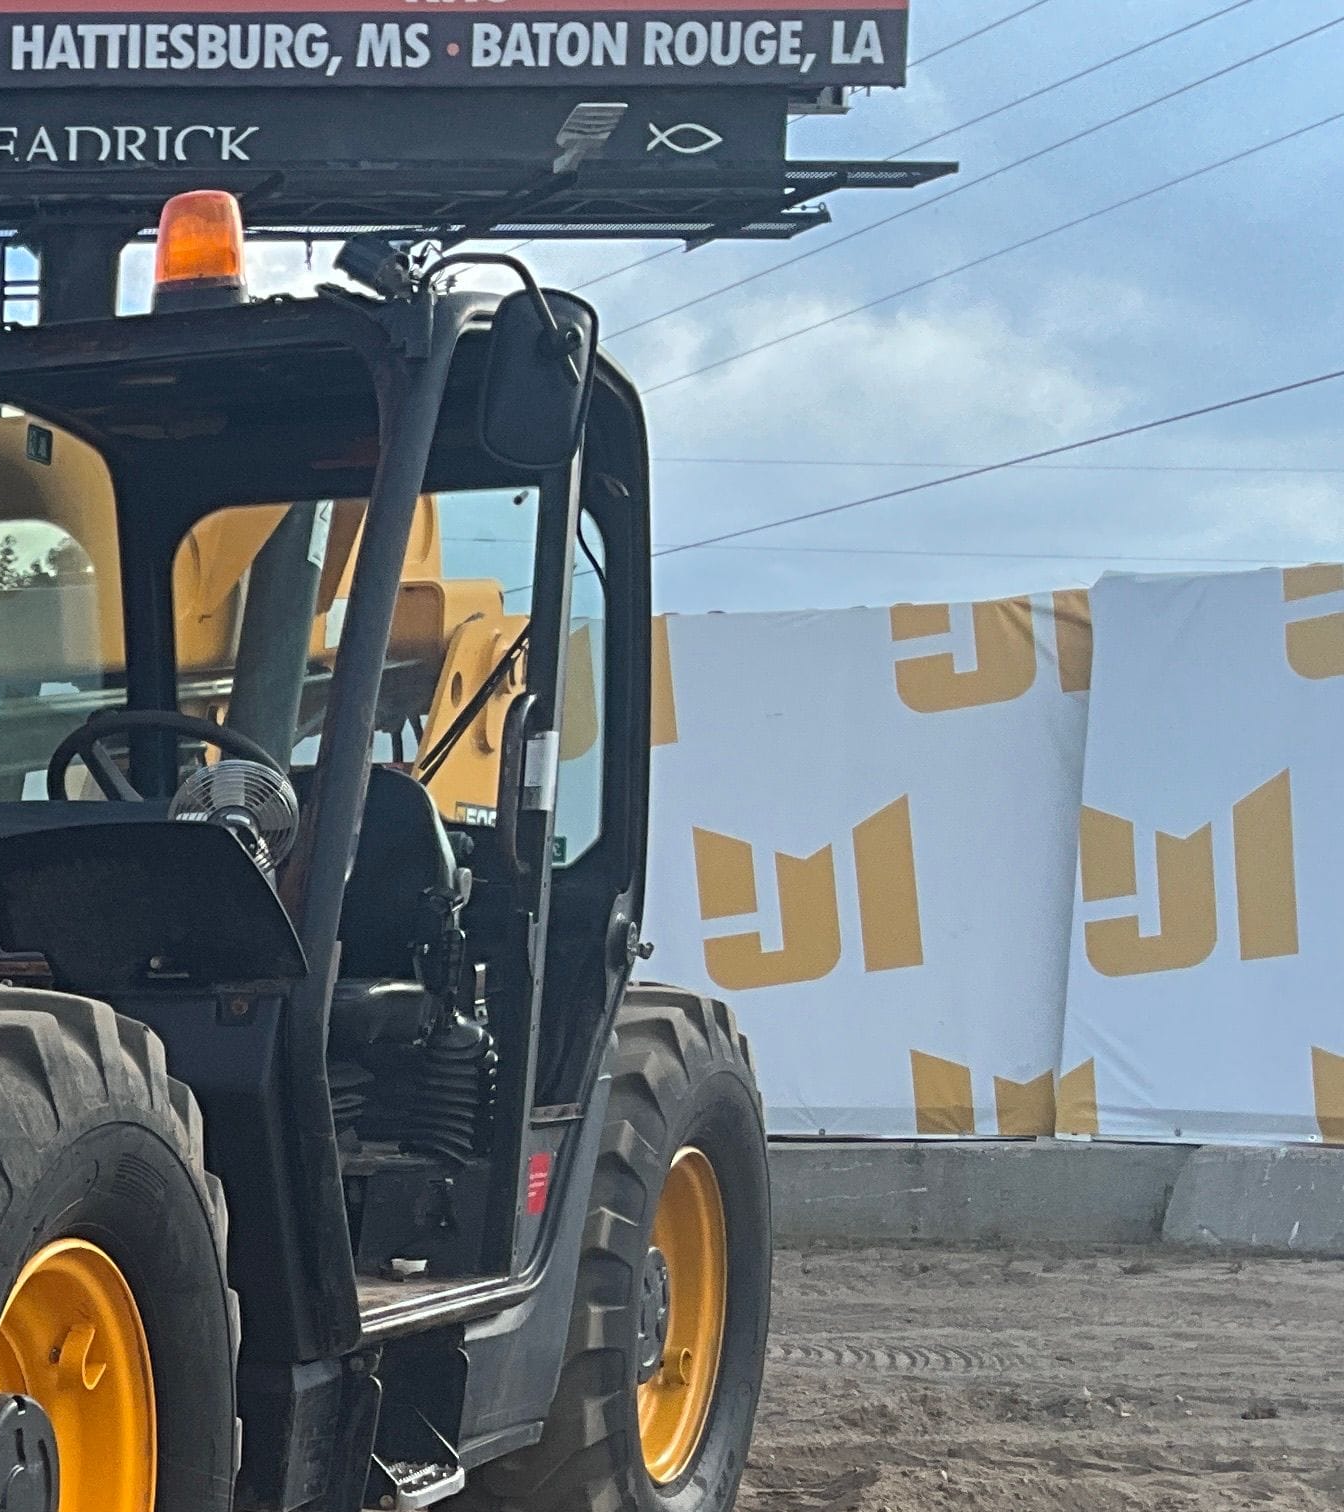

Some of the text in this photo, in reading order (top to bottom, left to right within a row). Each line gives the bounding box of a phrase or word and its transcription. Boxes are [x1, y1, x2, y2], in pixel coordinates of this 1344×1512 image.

[11, 21, 341, 76] HATTIESBURG,
[356, 20, 430, 69] MS
[471, 20, 628, 69] BATON
[643, 18, 816, 74] ROUGE,
[831, 18, 884, 67] LA
